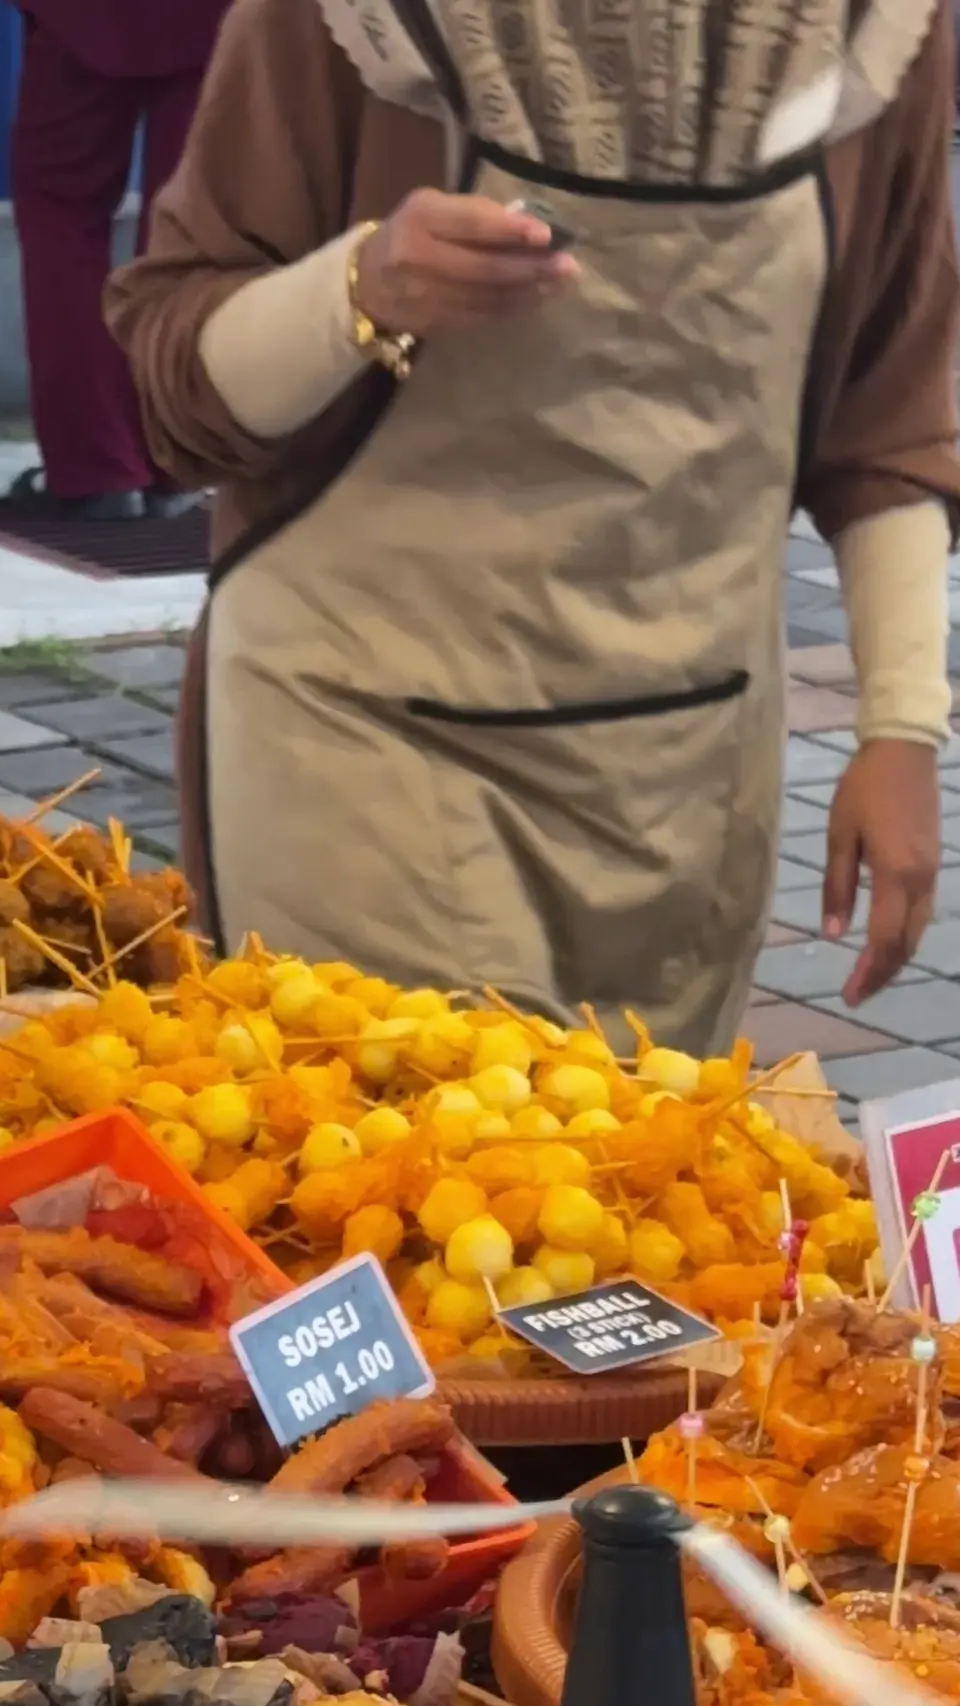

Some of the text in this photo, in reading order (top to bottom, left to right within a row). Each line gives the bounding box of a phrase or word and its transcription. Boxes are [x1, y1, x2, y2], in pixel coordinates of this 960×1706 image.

[278, 1301, 361, 1367] SOSEJ
[522, 1291, 651, 1332] FISHBALL
[573, 1319, 683, 1358] RM 2.00
[286, 1340, 394, 1421] RM 1.00
